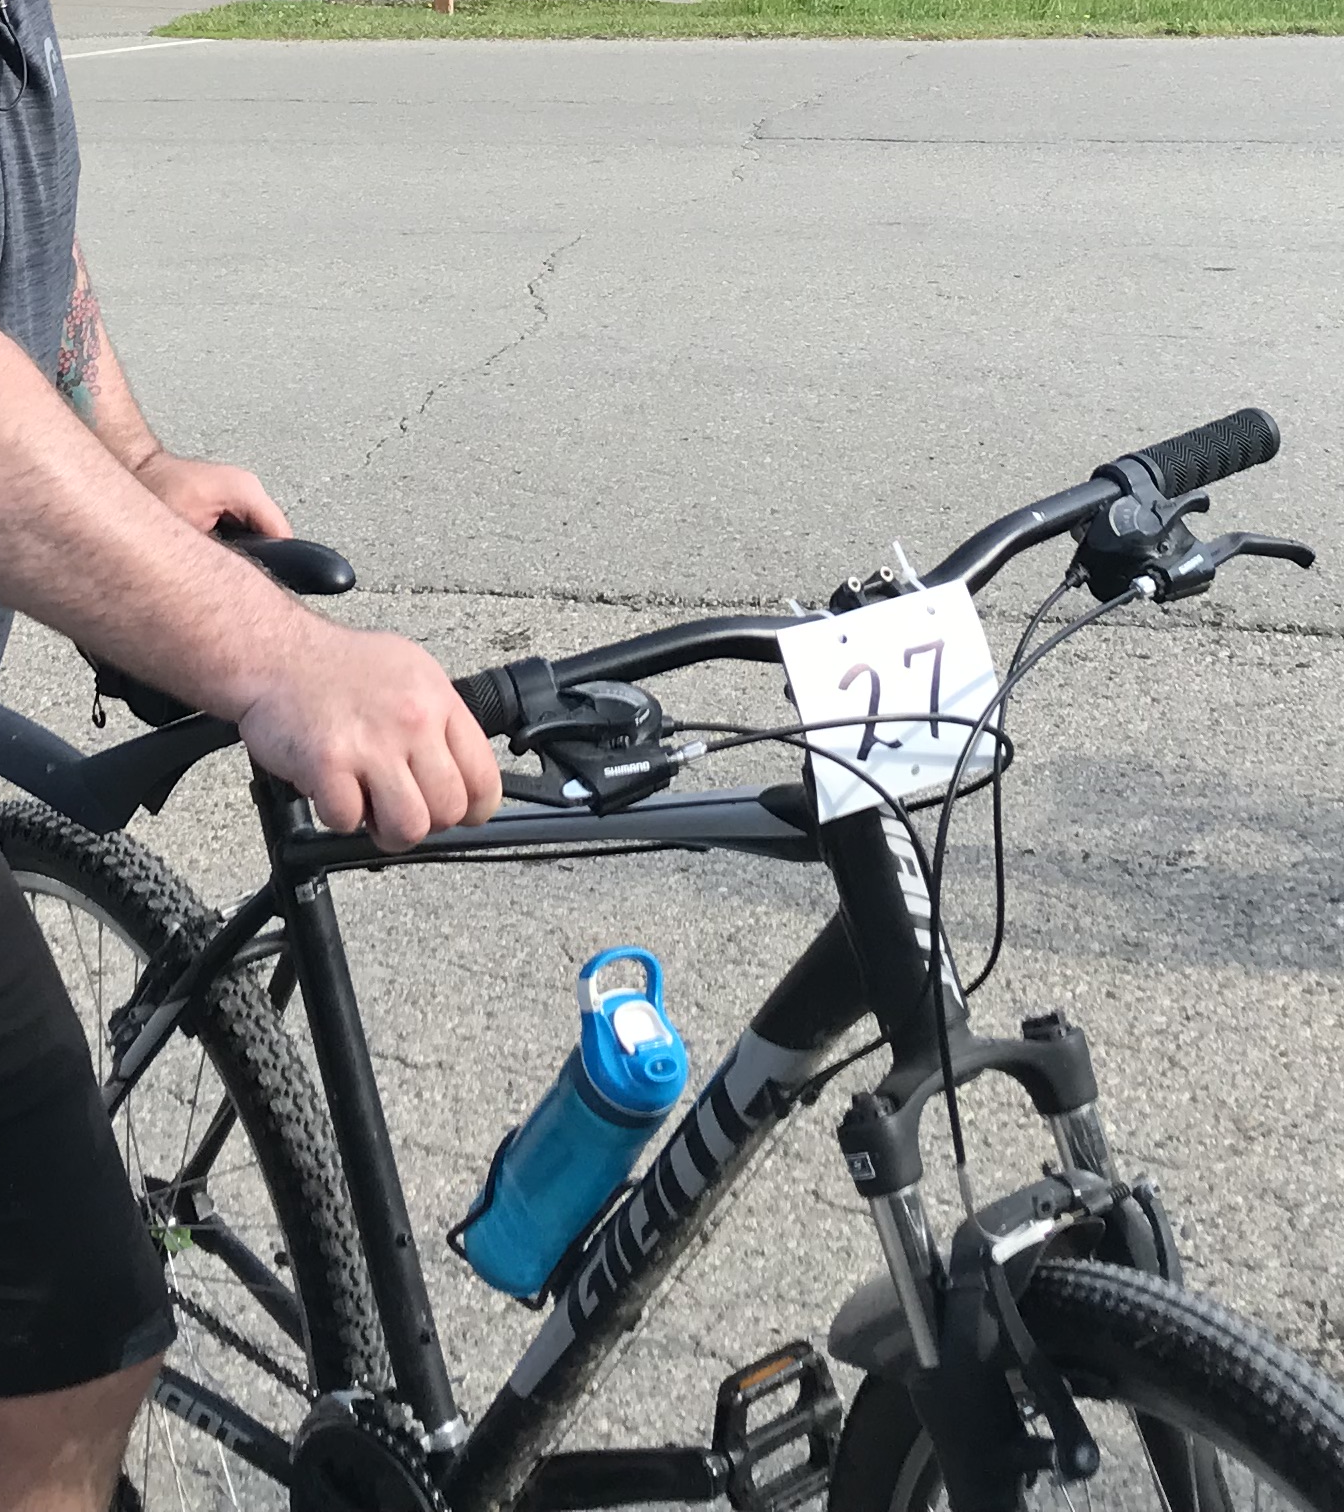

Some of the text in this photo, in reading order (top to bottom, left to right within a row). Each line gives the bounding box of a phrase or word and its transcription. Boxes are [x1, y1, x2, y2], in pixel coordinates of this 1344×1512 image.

[838, 638, 946, 761] 27
[603, 760, 651, 778] SHIMANO
[878, 804, 966, 1009] IANT
